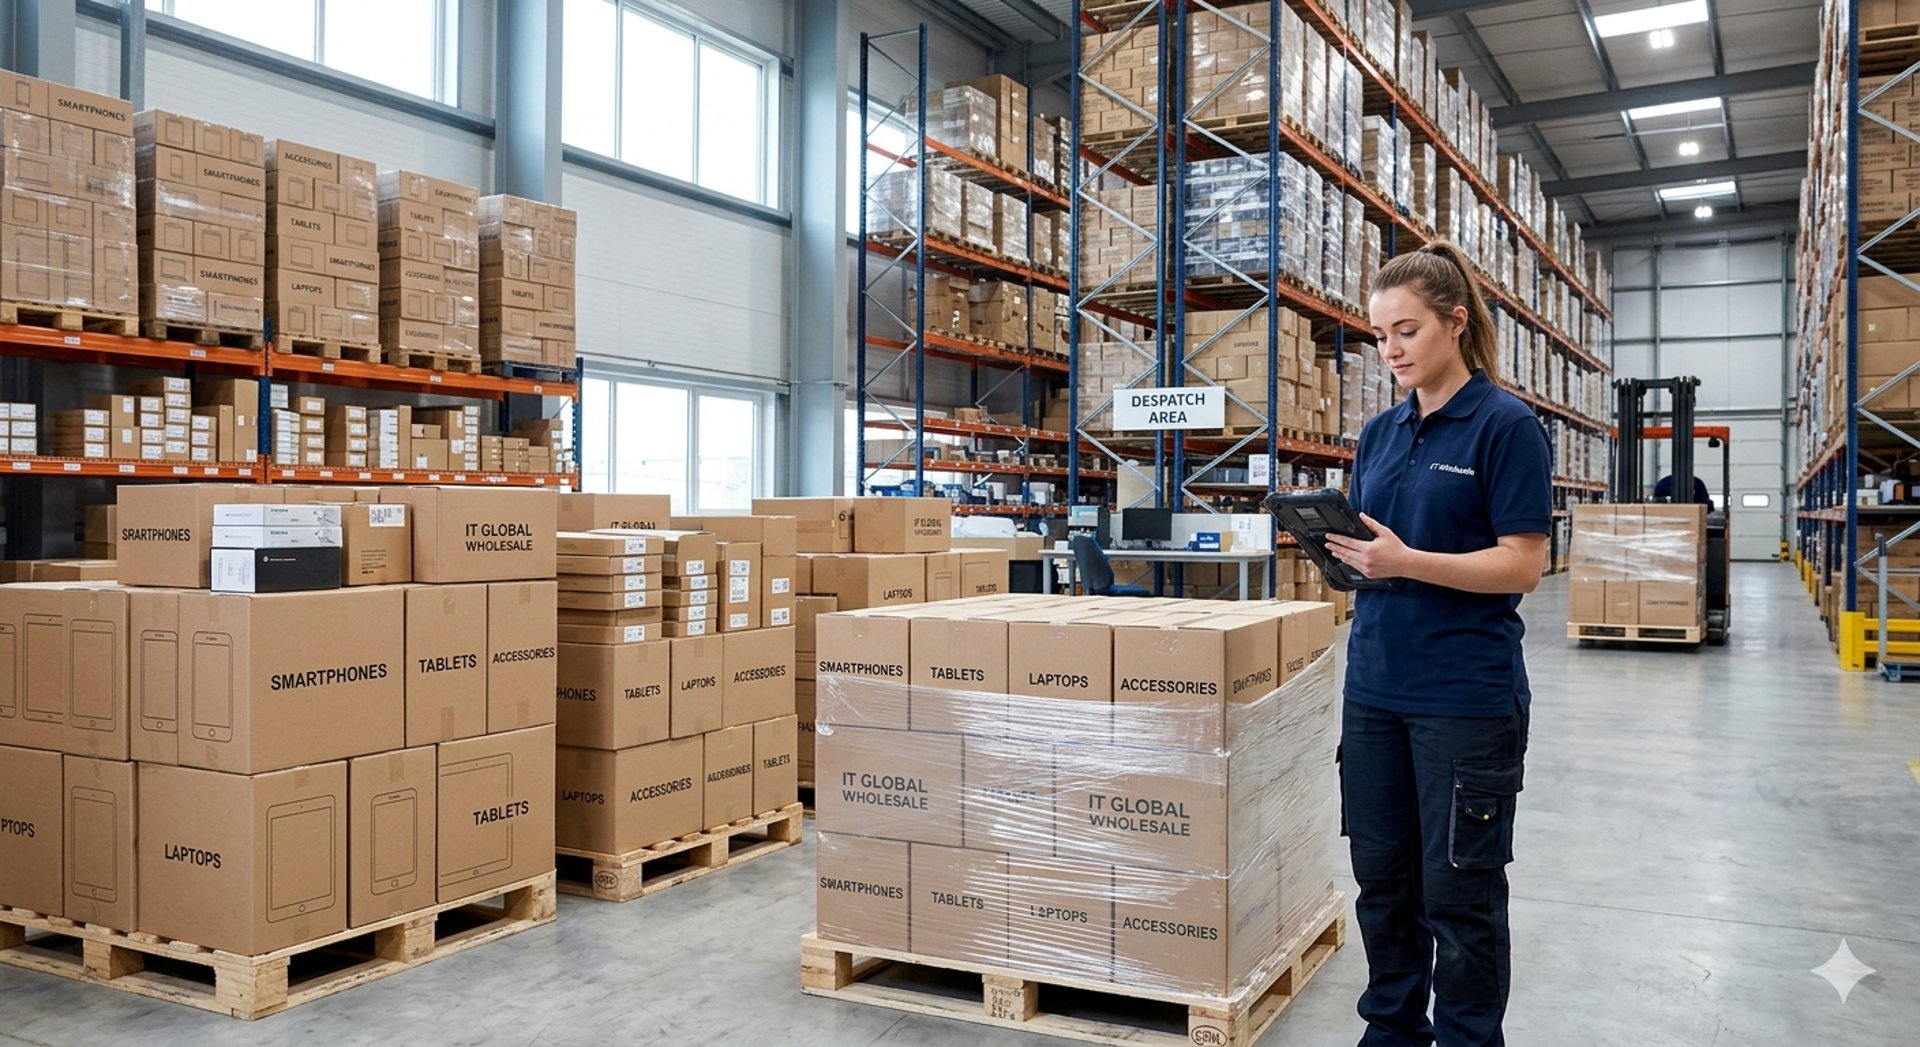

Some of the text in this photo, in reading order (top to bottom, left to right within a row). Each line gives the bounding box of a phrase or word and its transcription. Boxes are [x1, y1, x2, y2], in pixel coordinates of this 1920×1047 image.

[1131, 392, 1206, 408] DESPATCH
[1148, 411, 1188, 424] AREA
[465, 523, 533, 537] IT GLOBAL
[465, 540, 533, 552] WHOLESALE
[419, 654, 477, 673] TABLETS
[819, 660, 904, 677] SMARTPHONES
[270, 663, 387, 691] SMARTPHONES
[930, 667, 985, 682] TABLETS
[1029, 672, 1089, 689] LAPTOPS
[624, 685, 661, 700] TABLETS
[1120, 678, 1218, 696] ACCESSORIES
[630, 777, 693, 803] ACCESSORIES
[842, 772, 928, 793] IT GLOBAL
[562, 789, 605, 806] LAPTOPS
[842, 790, 928, 810] WHOLESALE
[1089, 794, 1190, 819] IT GLOBAL
[473, 800, 529, 826] TABLETS
[0, 818, 35, 838] PTOPS
[1089, 813, 1190, 837] WHOLESALE
[164, 843, 222, 869] LAPTOPS
[931, 891, 984, 910] TABLETS
[1122, 917, 1218, 940] ACCESSORIES
